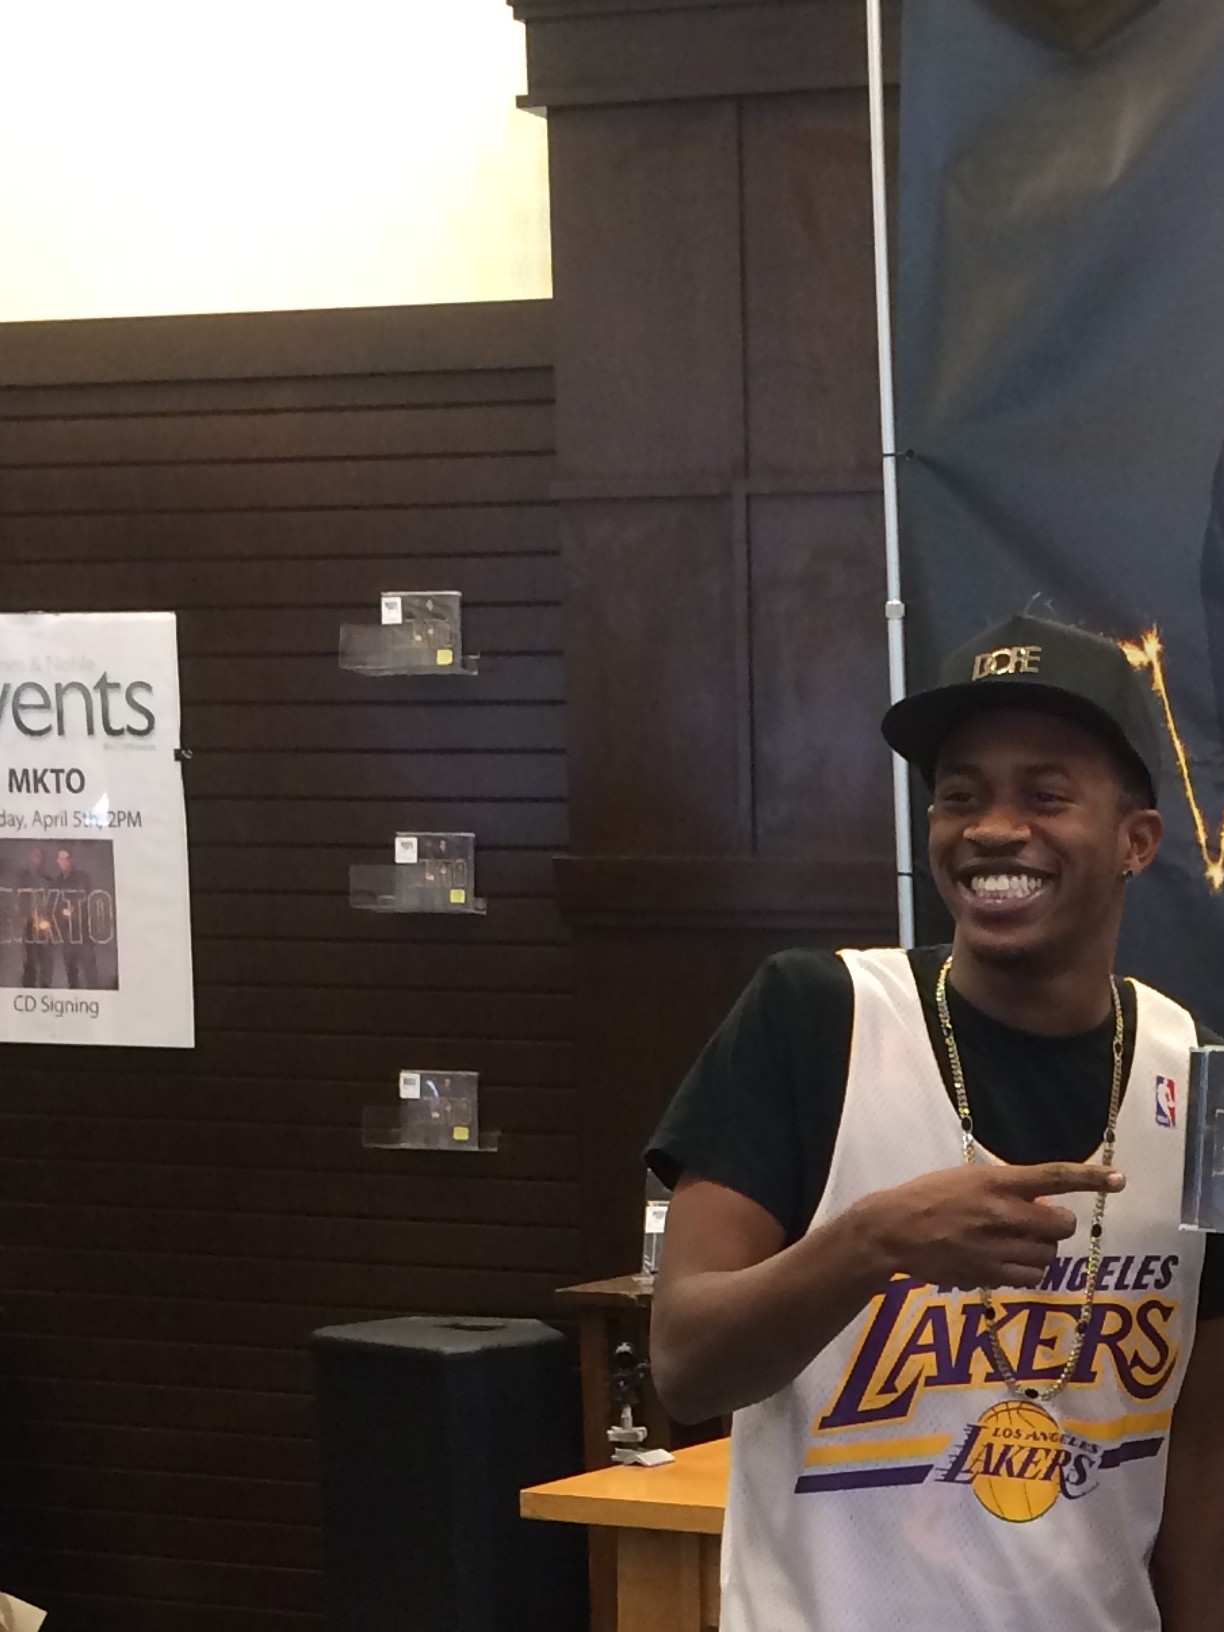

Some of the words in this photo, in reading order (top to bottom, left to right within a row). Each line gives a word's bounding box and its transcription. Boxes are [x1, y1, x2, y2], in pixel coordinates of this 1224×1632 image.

[971, 645, 1042, 681] DOPE
[8, 767, 86, 794] MKTO
[32, 809, 69, 832] April
[107, 810, 142, 828] 2PM
[13, 994, 37, 1012] CD
[41, 994, 100, 1019] Signing
[1034, 1254, 1179, 1292] NGELES
[815, 1273, 1180, 1431] LAKERS
[992, 1426, 1023, 1440] LOS
[1025, 1429, 1103, 1454] ANGELES
[934, 1423, 1101, 1500] LAKERS
